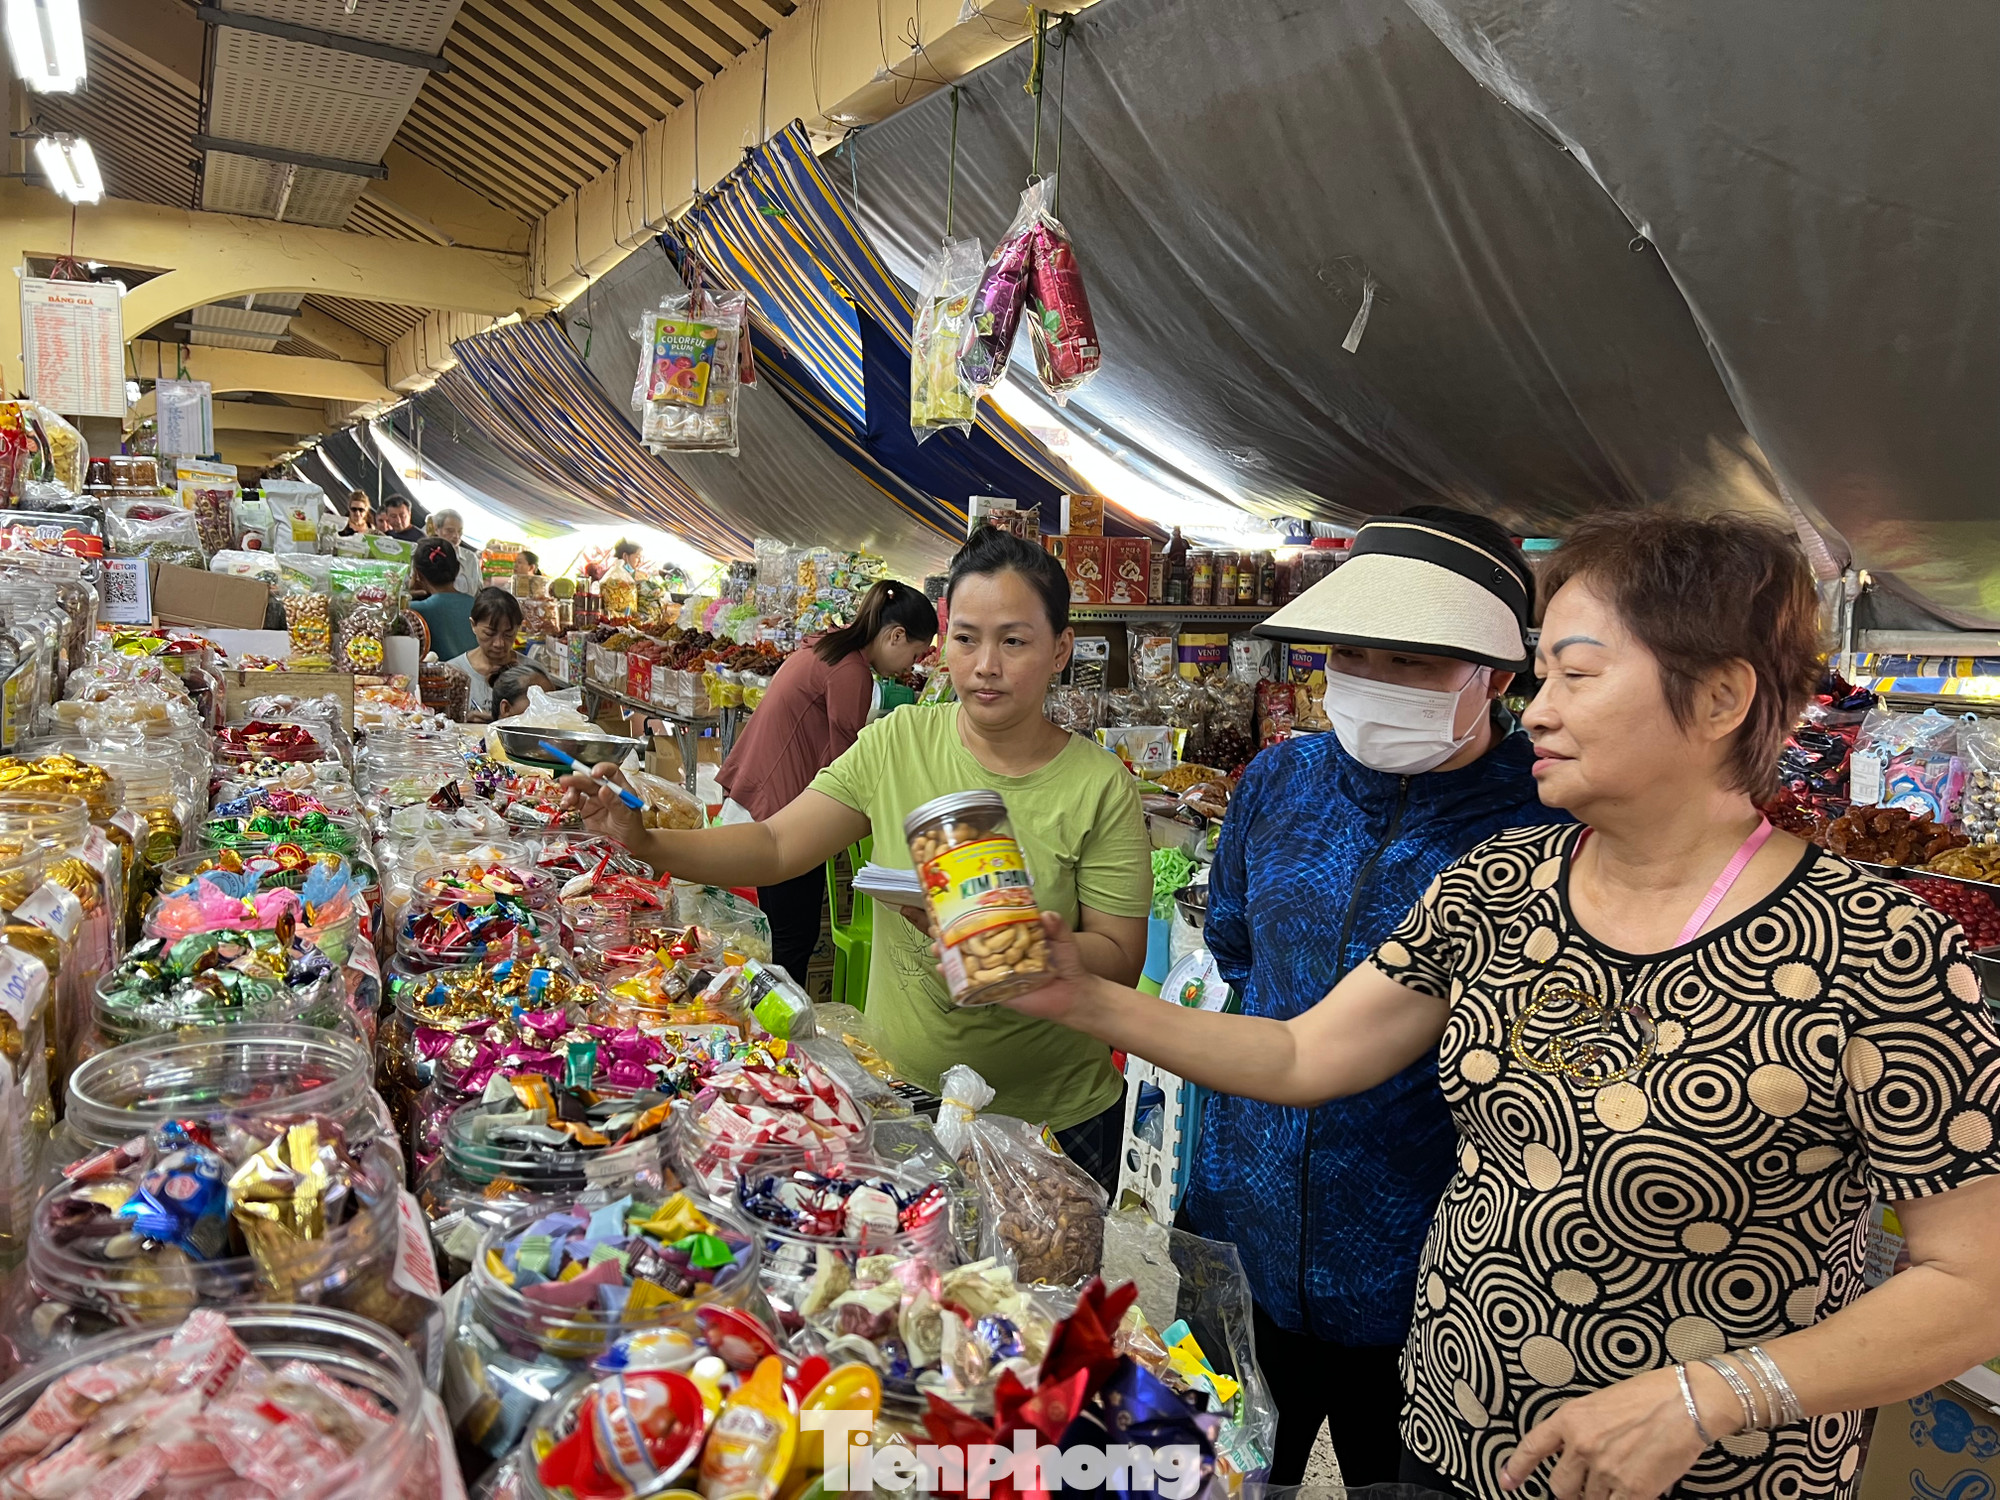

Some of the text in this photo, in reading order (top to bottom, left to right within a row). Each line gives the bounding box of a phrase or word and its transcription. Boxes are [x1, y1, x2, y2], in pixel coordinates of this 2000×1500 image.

[48, 295, 74, 304] BẢNG
[76, 297, 94, 305] GIÁ
[661, 335, 706, 348] COLORFUL
[671, 344, 694, 352] PLUM
[1197, 648, 1221, 657] VENTO
[1291, 653, 1313, 663] VENTO
